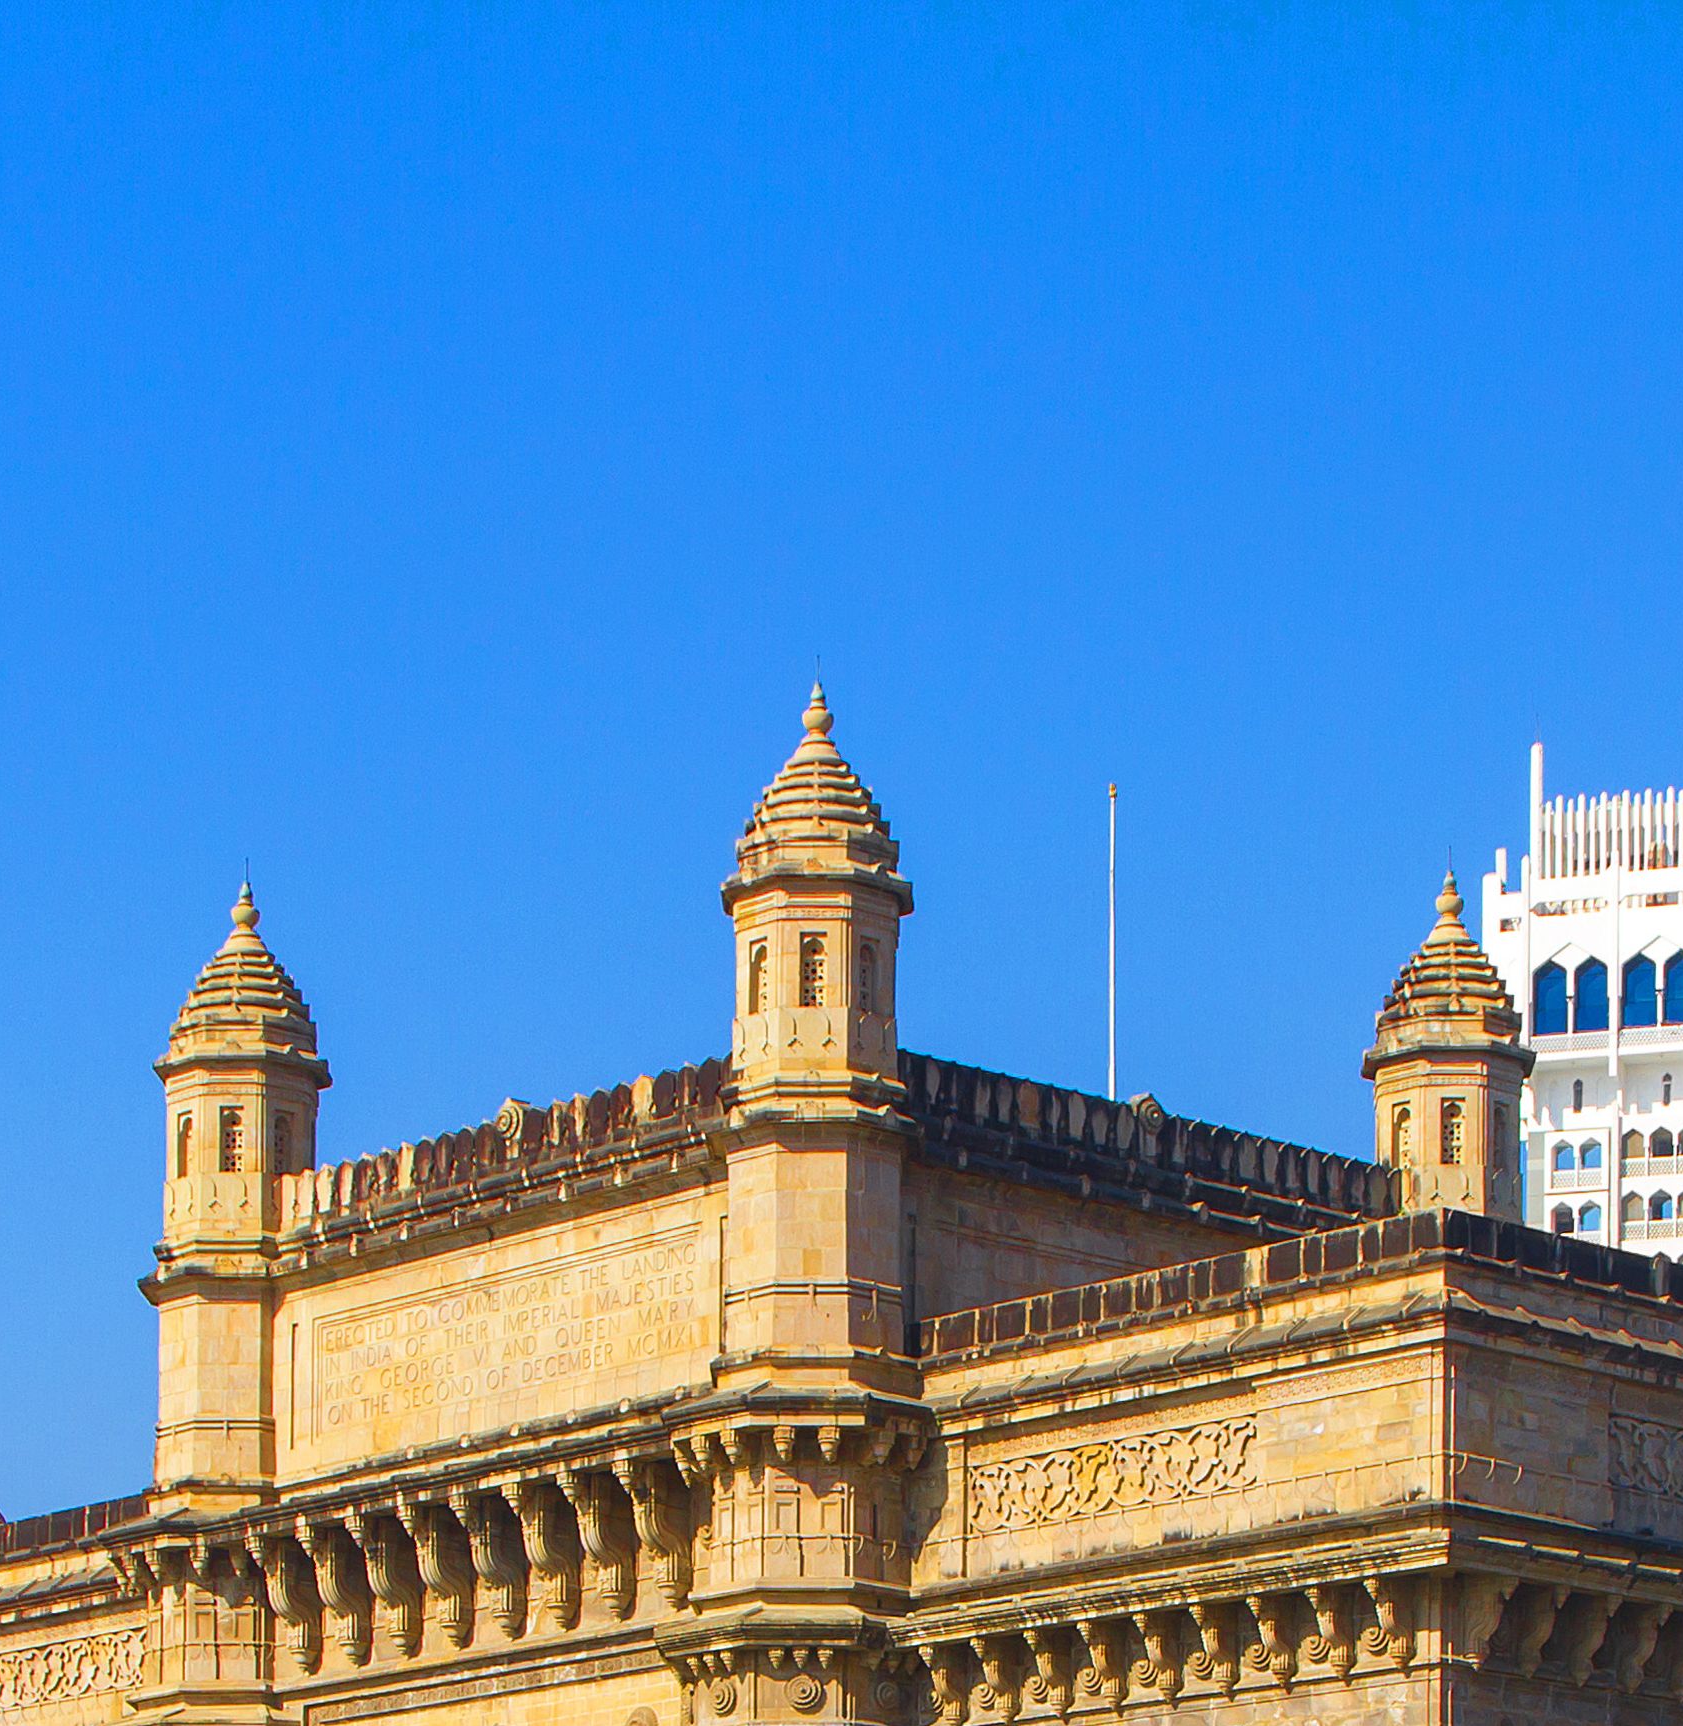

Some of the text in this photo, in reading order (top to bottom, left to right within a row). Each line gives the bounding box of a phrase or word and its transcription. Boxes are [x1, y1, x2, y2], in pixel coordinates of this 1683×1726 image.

[325, 1271, 694, 1377] IN INDIA OF THEIR IMPERIAL MAJESTIES
[325, 1375, 363, 1401] KING
[380, 1354, 455, 1389] GEORGE
[501, 1335, 537, 1362] AND
[556, 1315, 621, 1349] QUEEN
[638, 1298, 694, 1328] MARY
[326, 1243, 696, 1353] ERECTED TO COMMEMORATE THE LANDING
[328, 1324, 693, 1425] ON THE SECOND OF DECEMBER MCMXI
